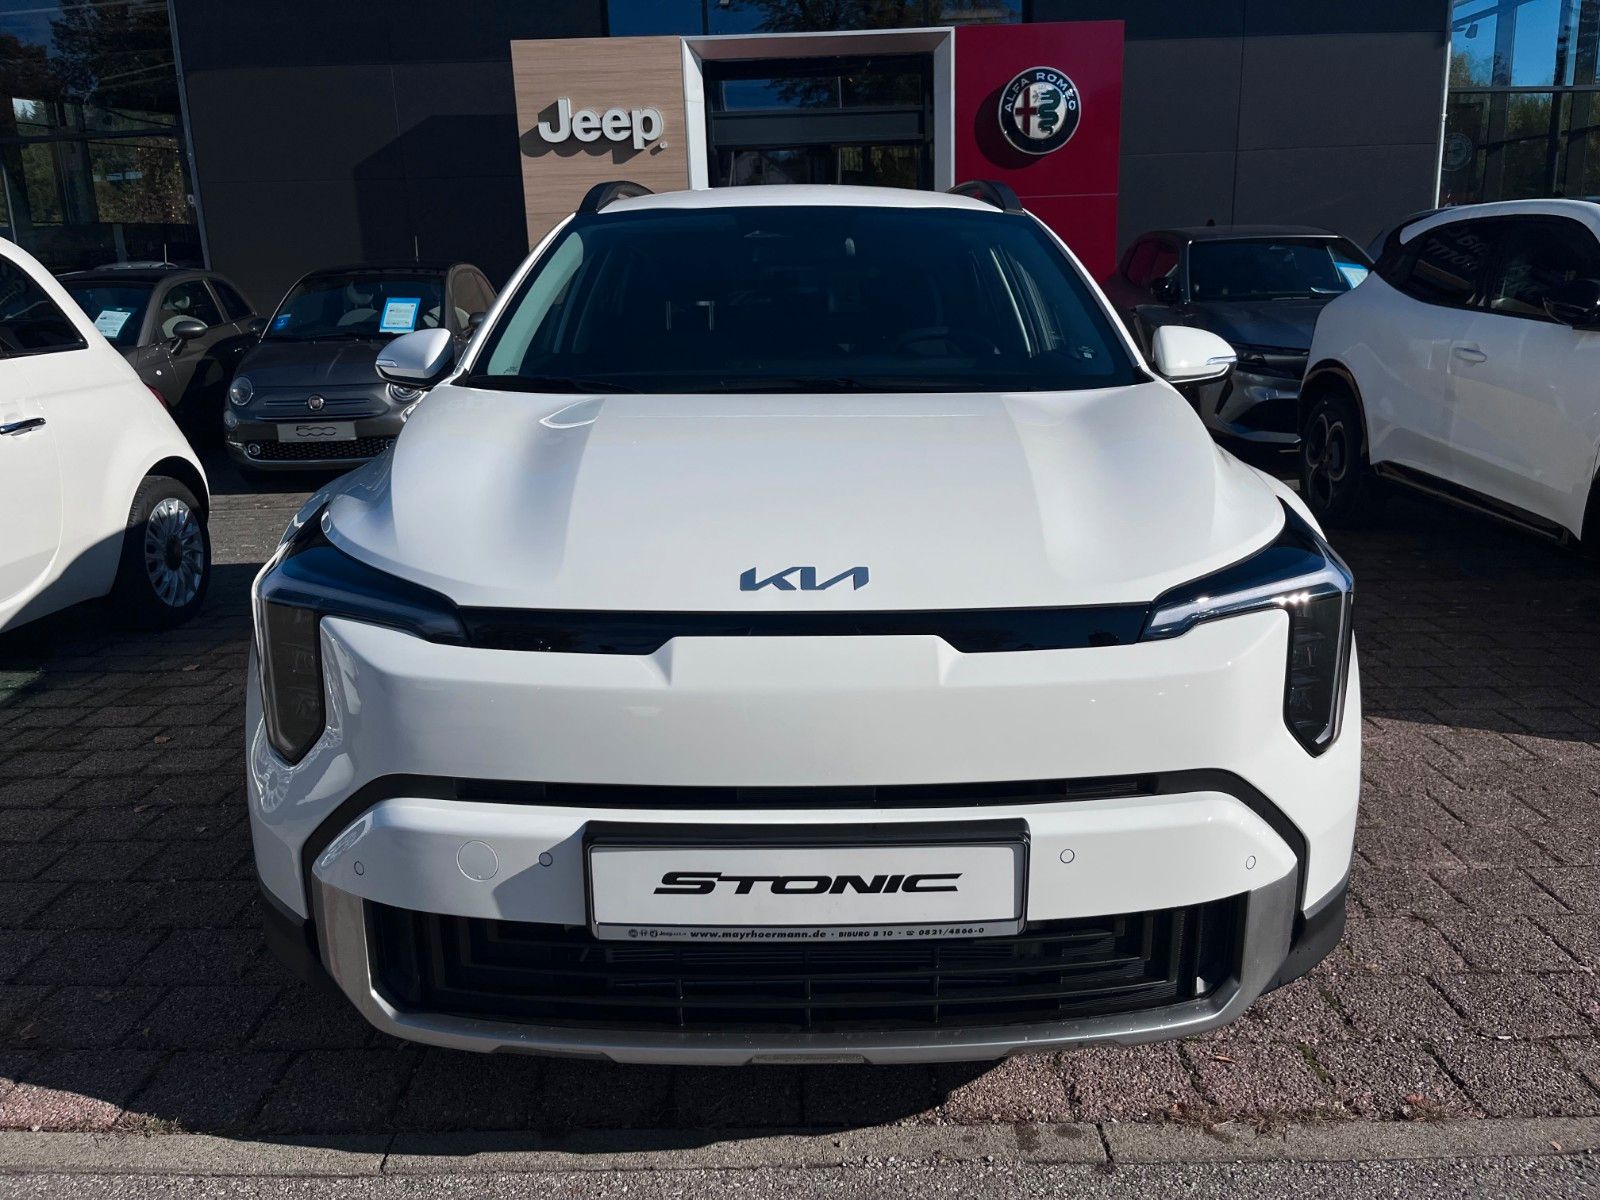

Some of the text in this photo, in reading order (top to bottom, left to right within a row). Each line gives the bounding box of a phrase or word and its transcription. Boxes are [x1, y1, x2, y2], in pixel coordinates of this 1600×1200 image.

[1005, 72, 1077, 112] ALFA ROMEO
[537, 96, 664, 150] Jeep
[739, 566, 870, 591] KIA
[653, 871, 964, 895] STONIC
[690, 929, 827, 940] www.mayrhoermann.de
[918, 927, 985, 936] 0821/4866-0
